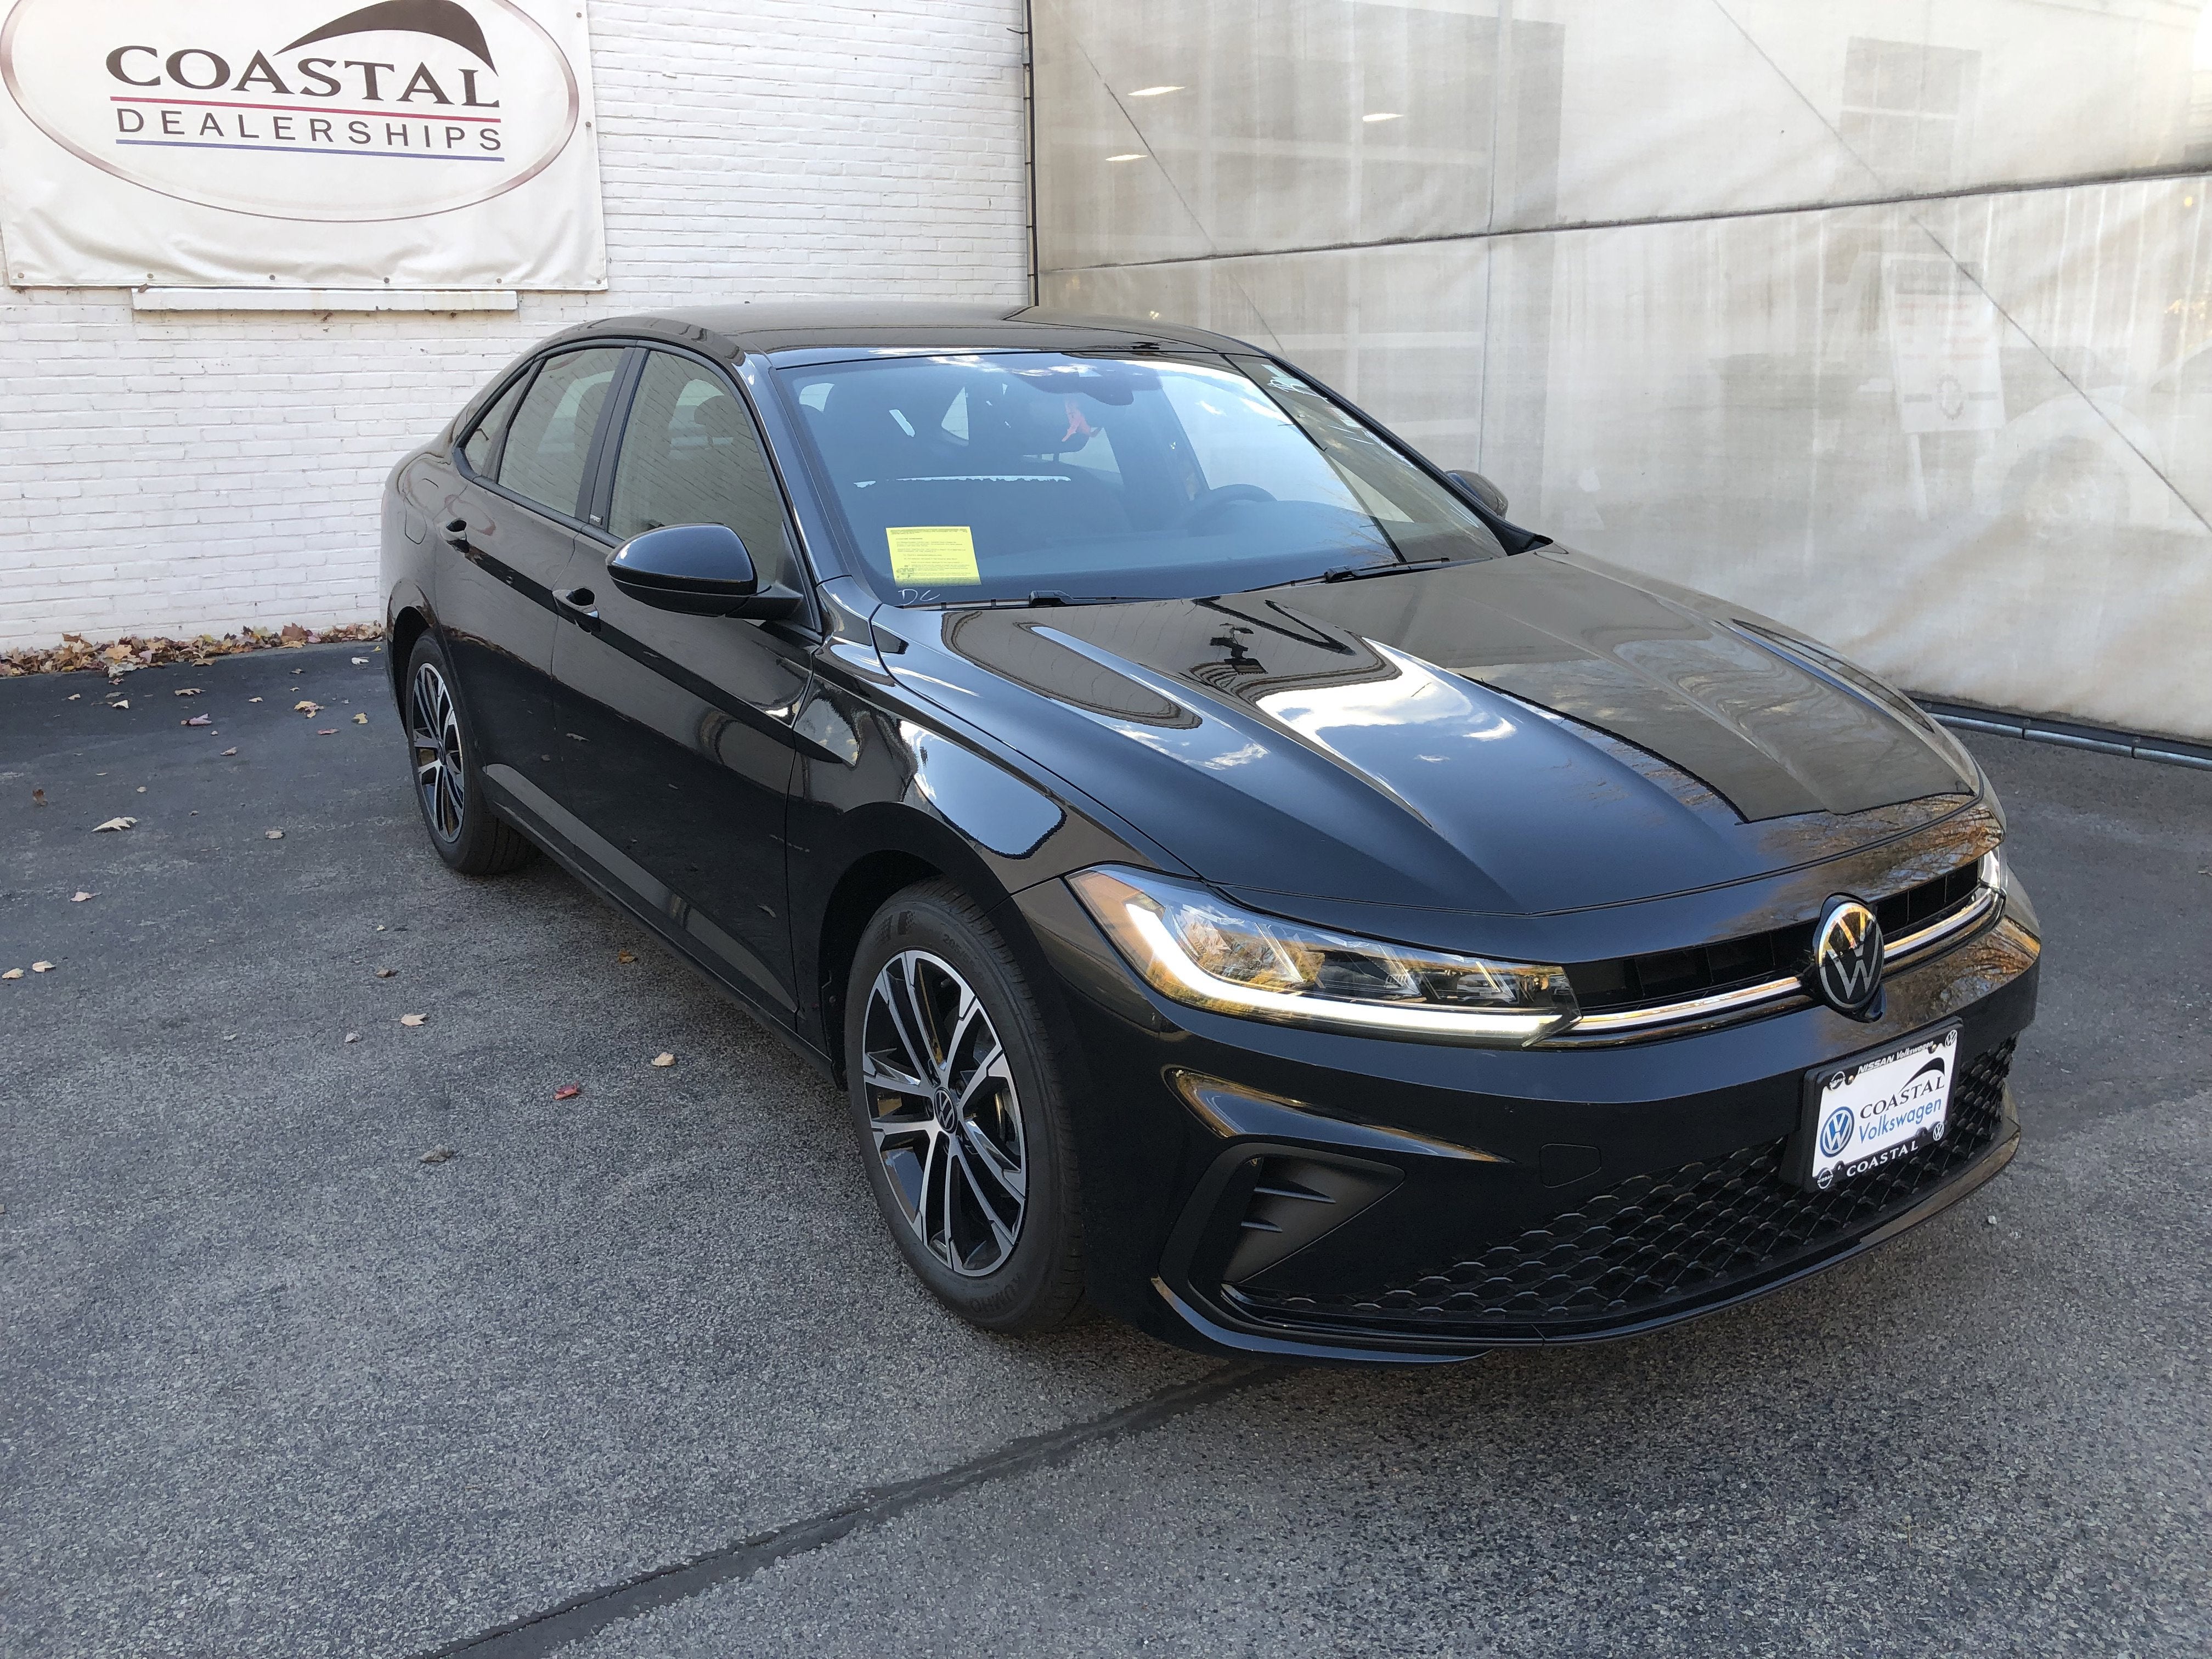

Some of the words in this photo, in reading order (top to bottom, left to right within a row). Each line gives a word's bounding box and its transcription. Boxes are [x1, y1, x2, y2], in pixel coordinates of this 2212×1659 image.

[106, 45, 500, 108] COASTAL
[116, 108, 503, 151] DEALERSHIPS
[1858, 1054, 1894, 1075] NISSAN
[1897, 1041, 1934, 1060] Volkswagen
[1860, 1076, 1945, 1119] COASTAL
[1859, 1098, 1942, 1144] Volkswagen
[1846, 1141, 1918, 1177] COASTAL
